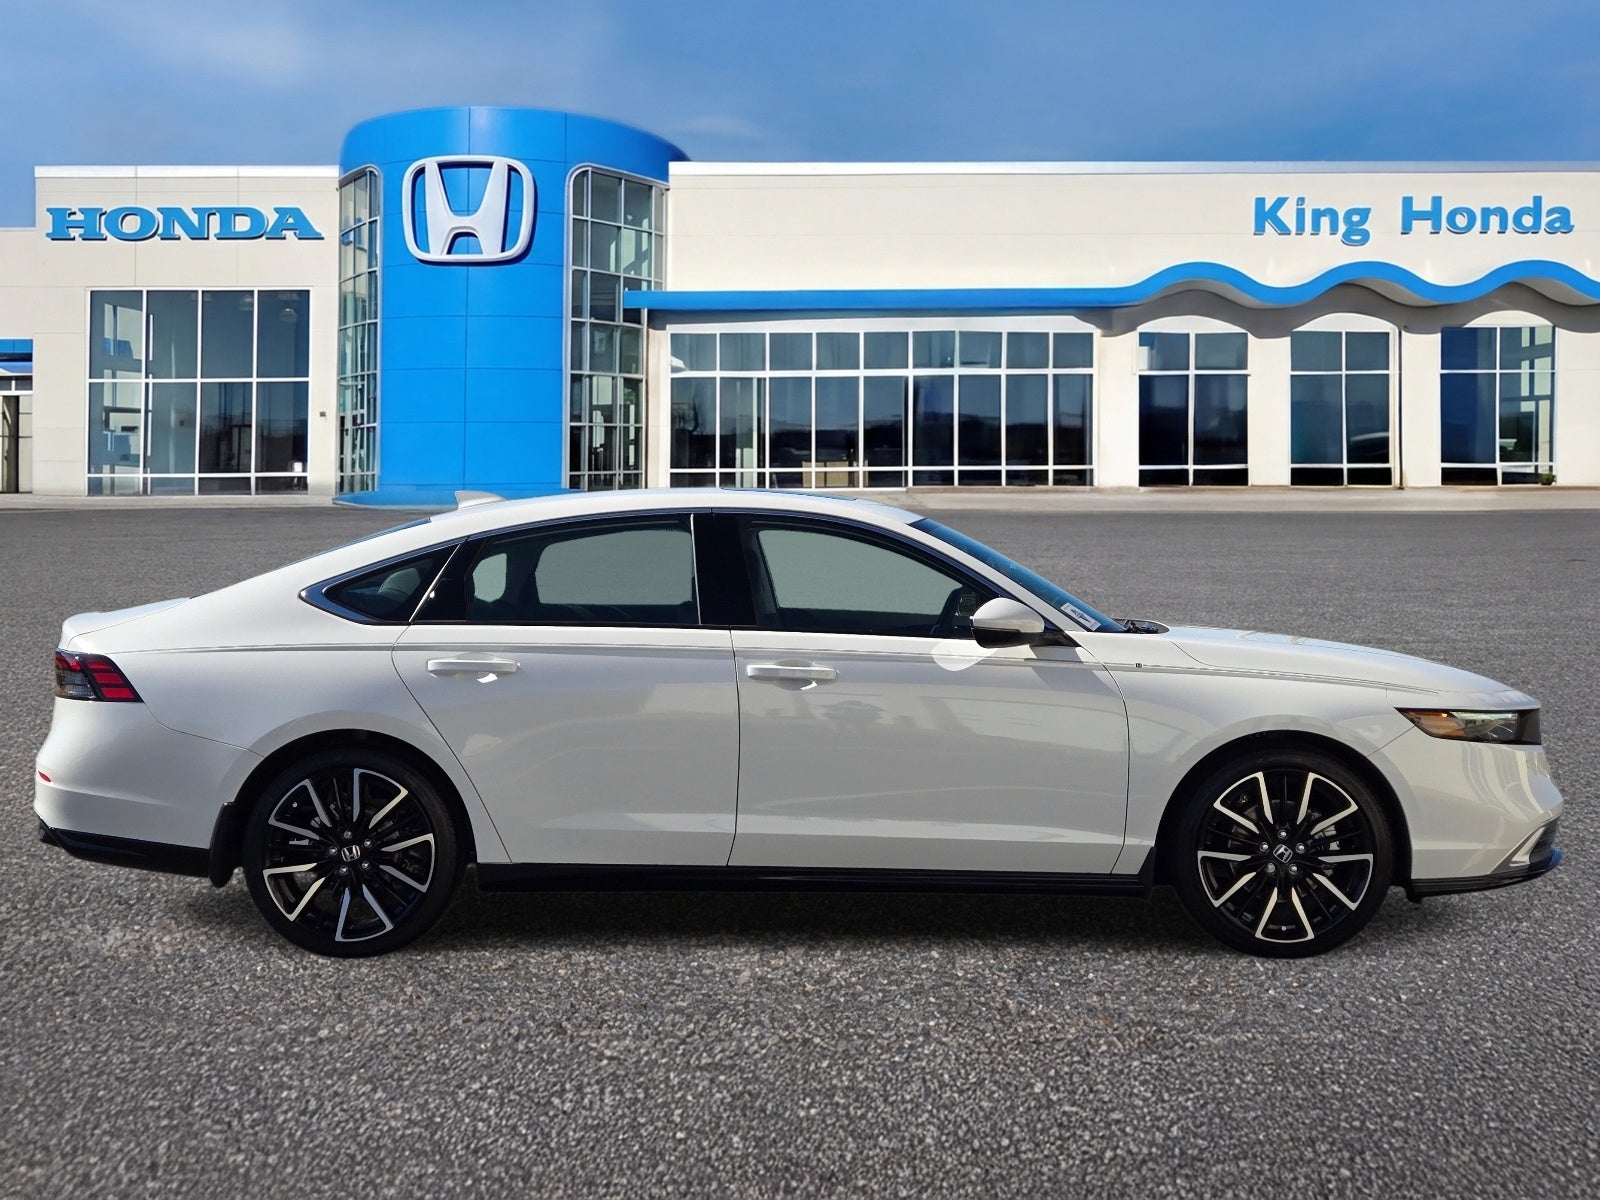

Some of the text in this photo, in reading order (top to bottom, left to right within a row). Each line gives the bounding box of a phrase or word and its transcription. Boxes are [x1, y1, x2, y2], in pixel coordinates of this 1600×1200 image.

[45, 206, 325, 242] HONDA
[1253, 195, 1575, 247] King Honda
